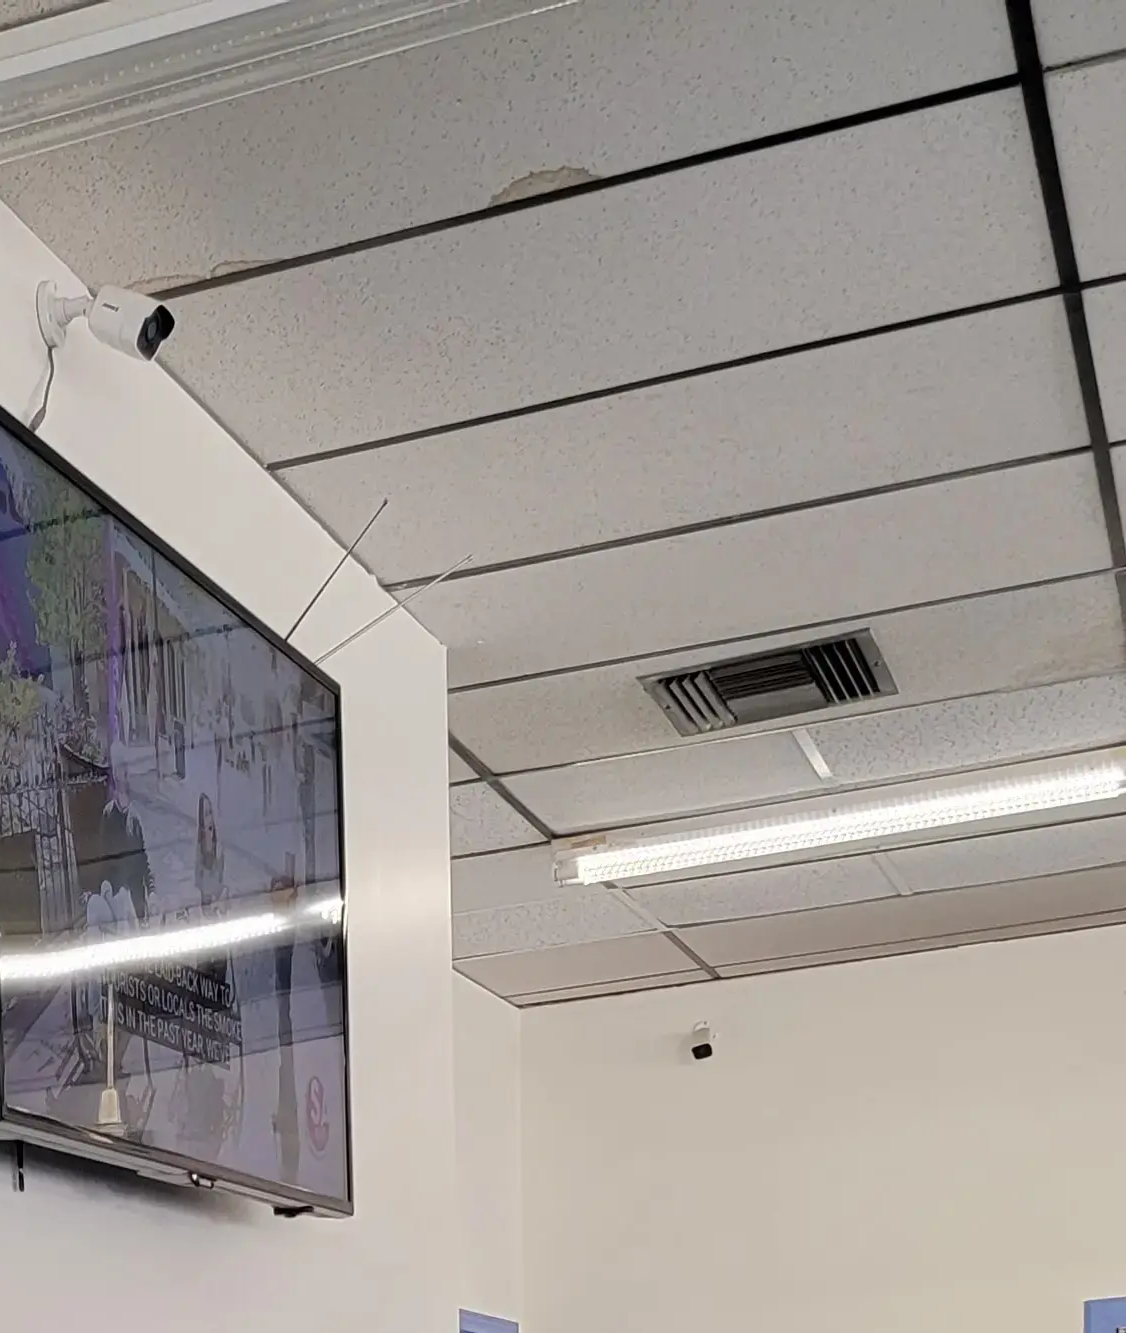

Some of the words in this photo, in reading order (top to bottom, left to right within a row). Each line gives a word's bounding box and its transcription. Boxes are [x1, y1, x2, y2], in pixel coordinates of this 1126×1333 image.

[199, 976, 220, 1003] WAY
[220, 984, 231, 1008] TO
[126, 1006, 136, 1029] IN
[137, 1010, 156, 1038] THE
[157, 1018, 180, 1045] PAST
[148, 984, 161, 1008] OR
[161, 989, 195, 1022] LOCALS
[196, 1003, 213, 1030] THE
[214, 1011, 242, 1042] SMOKE
